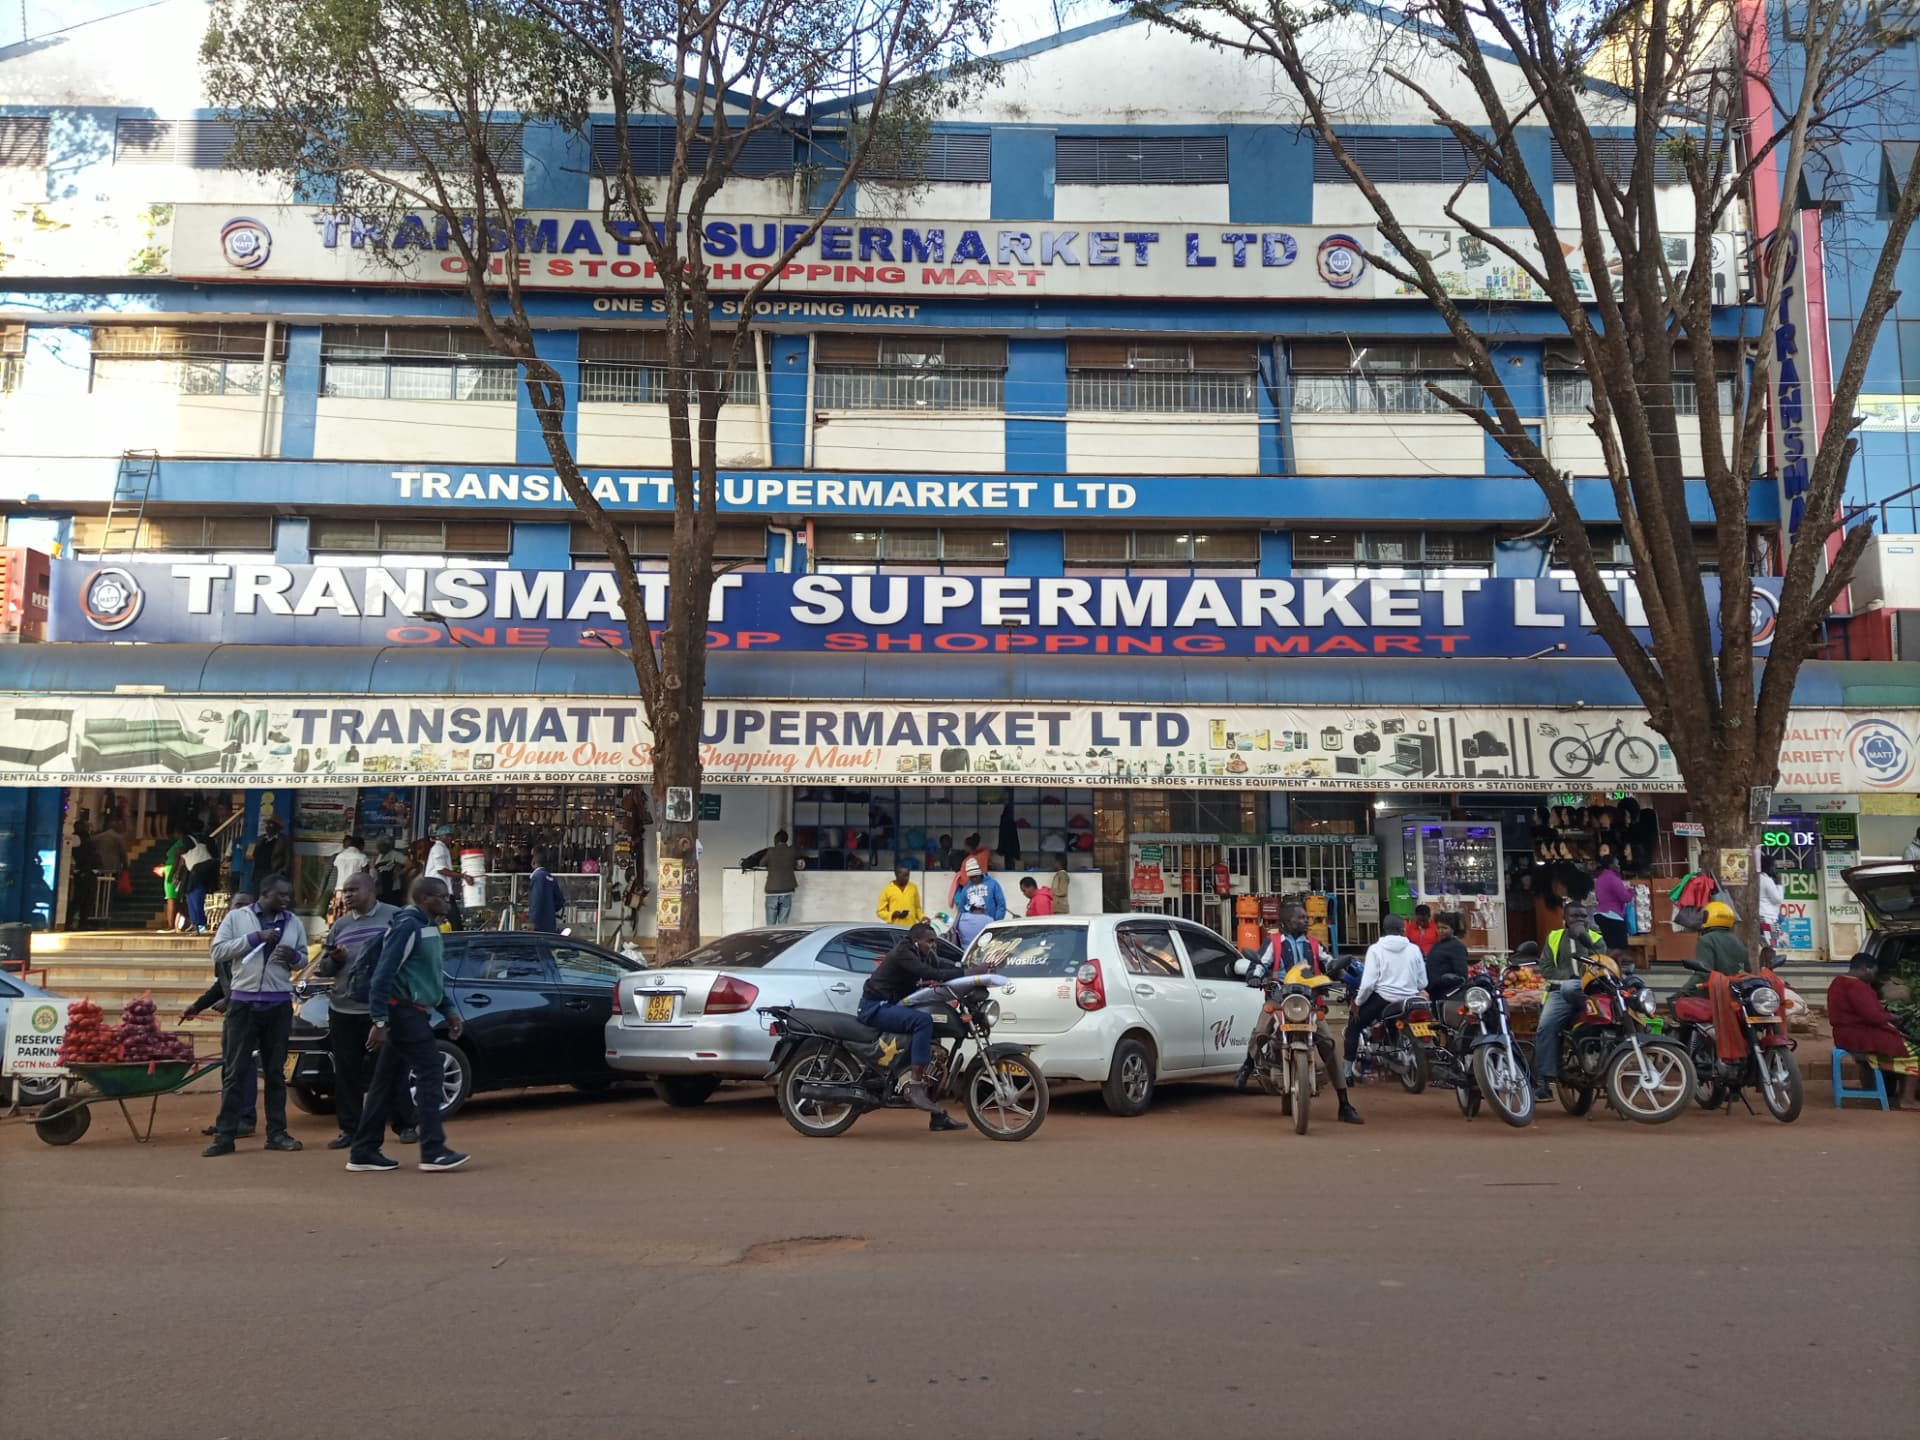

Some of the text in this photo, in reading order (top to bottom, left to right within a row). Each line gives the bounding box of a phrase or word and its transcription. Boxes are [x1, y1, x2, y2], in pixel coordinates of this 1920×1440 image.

[703, 221, 1158, 267] SUPERMARKET
[1186, 232, 1298, 267] LTD
[921, 268, 1046, 287] MART
[594, 298, 643, 313] ONE
[651, 300, 714, 315] SOP
[862, 302, 920, 320] MART
[1053, 482, 1137, 510] LTD
[171, 564, 743, 622] TRANSMATT
[790, 575, 1482, 628] SUPERMARKET
[386, 626, 550, 645] ONE
[824, 632, 1226, 653] SHOPPING
[1254, 634, 1470, 654] MART
[293, 707, 1190, 747] TRANSMATT UPERMARKET LTD
[497, 741, 567, 769] Your
[572, 741, 623, 766] One
[804, 745, 881, 770] Mart!
[1780, 750, 1845, 763] ARIETY
[1869, 751, 1892, 759] MATT
[61, 775, 102, 783] DRINKS
[113, 775, 146, 783] FRUIT
[160, 775, 183, 784] VEG
[194, 775, 245, 784] COOKING
[249, 775, 274, 784] OILS
[286, 776, 308, 784] HOT
[323, 775, 359, 784] FRESH
[363, 775, 406, 783] BAKERY
[418, 774, 460, 782] DENTAL
[464, 774, 493, 782] CARE
[504, 773, 530, 782] HAIR
[545, 773, 574, 781] BODY
[578, 774, 607, 782] CARE
[700, 775, 750, 783] ROCKERY
[762, 775, 837, 783] PLASTICWARE
[849, 776, 910, 784] FURNITURE
[920, 776, 951, 784] HOME
[954, 776, 990, 784] DECOR
[1002, 776, 1075, 784] ELECTRONICS
[1086, 776, 1140, 785] CLOTHING
[1151, 777, 1187, 785] SHOES
[1198, 778, 1242, 786] FITNESS
[1246, 778, 1308, 787] EQUIPMENT
[1320, 780, 1391, 789] MATTRESSES
[1401, 781, 1474, 790] GENERATORS
[1486, 781, 1553, 791] STATIONERY
[1565, 783, 1593, 791] TOYS
[1616, 783, 1638, 791] AND
[1642, 783, 1674, 791] MUCH
[1781, 772, 1842, 785] VALUE
[1272, 834, 1340, 843] COOKING
[1779, 903, 1806, 918] OPY
[1829, 904, 1859, 915] M-PESA
[649, 996, 666, 1009] KBY
[15, 1035, 65, 1045] RESERVE
[18, 1047, 57, 1057] PARKIN
